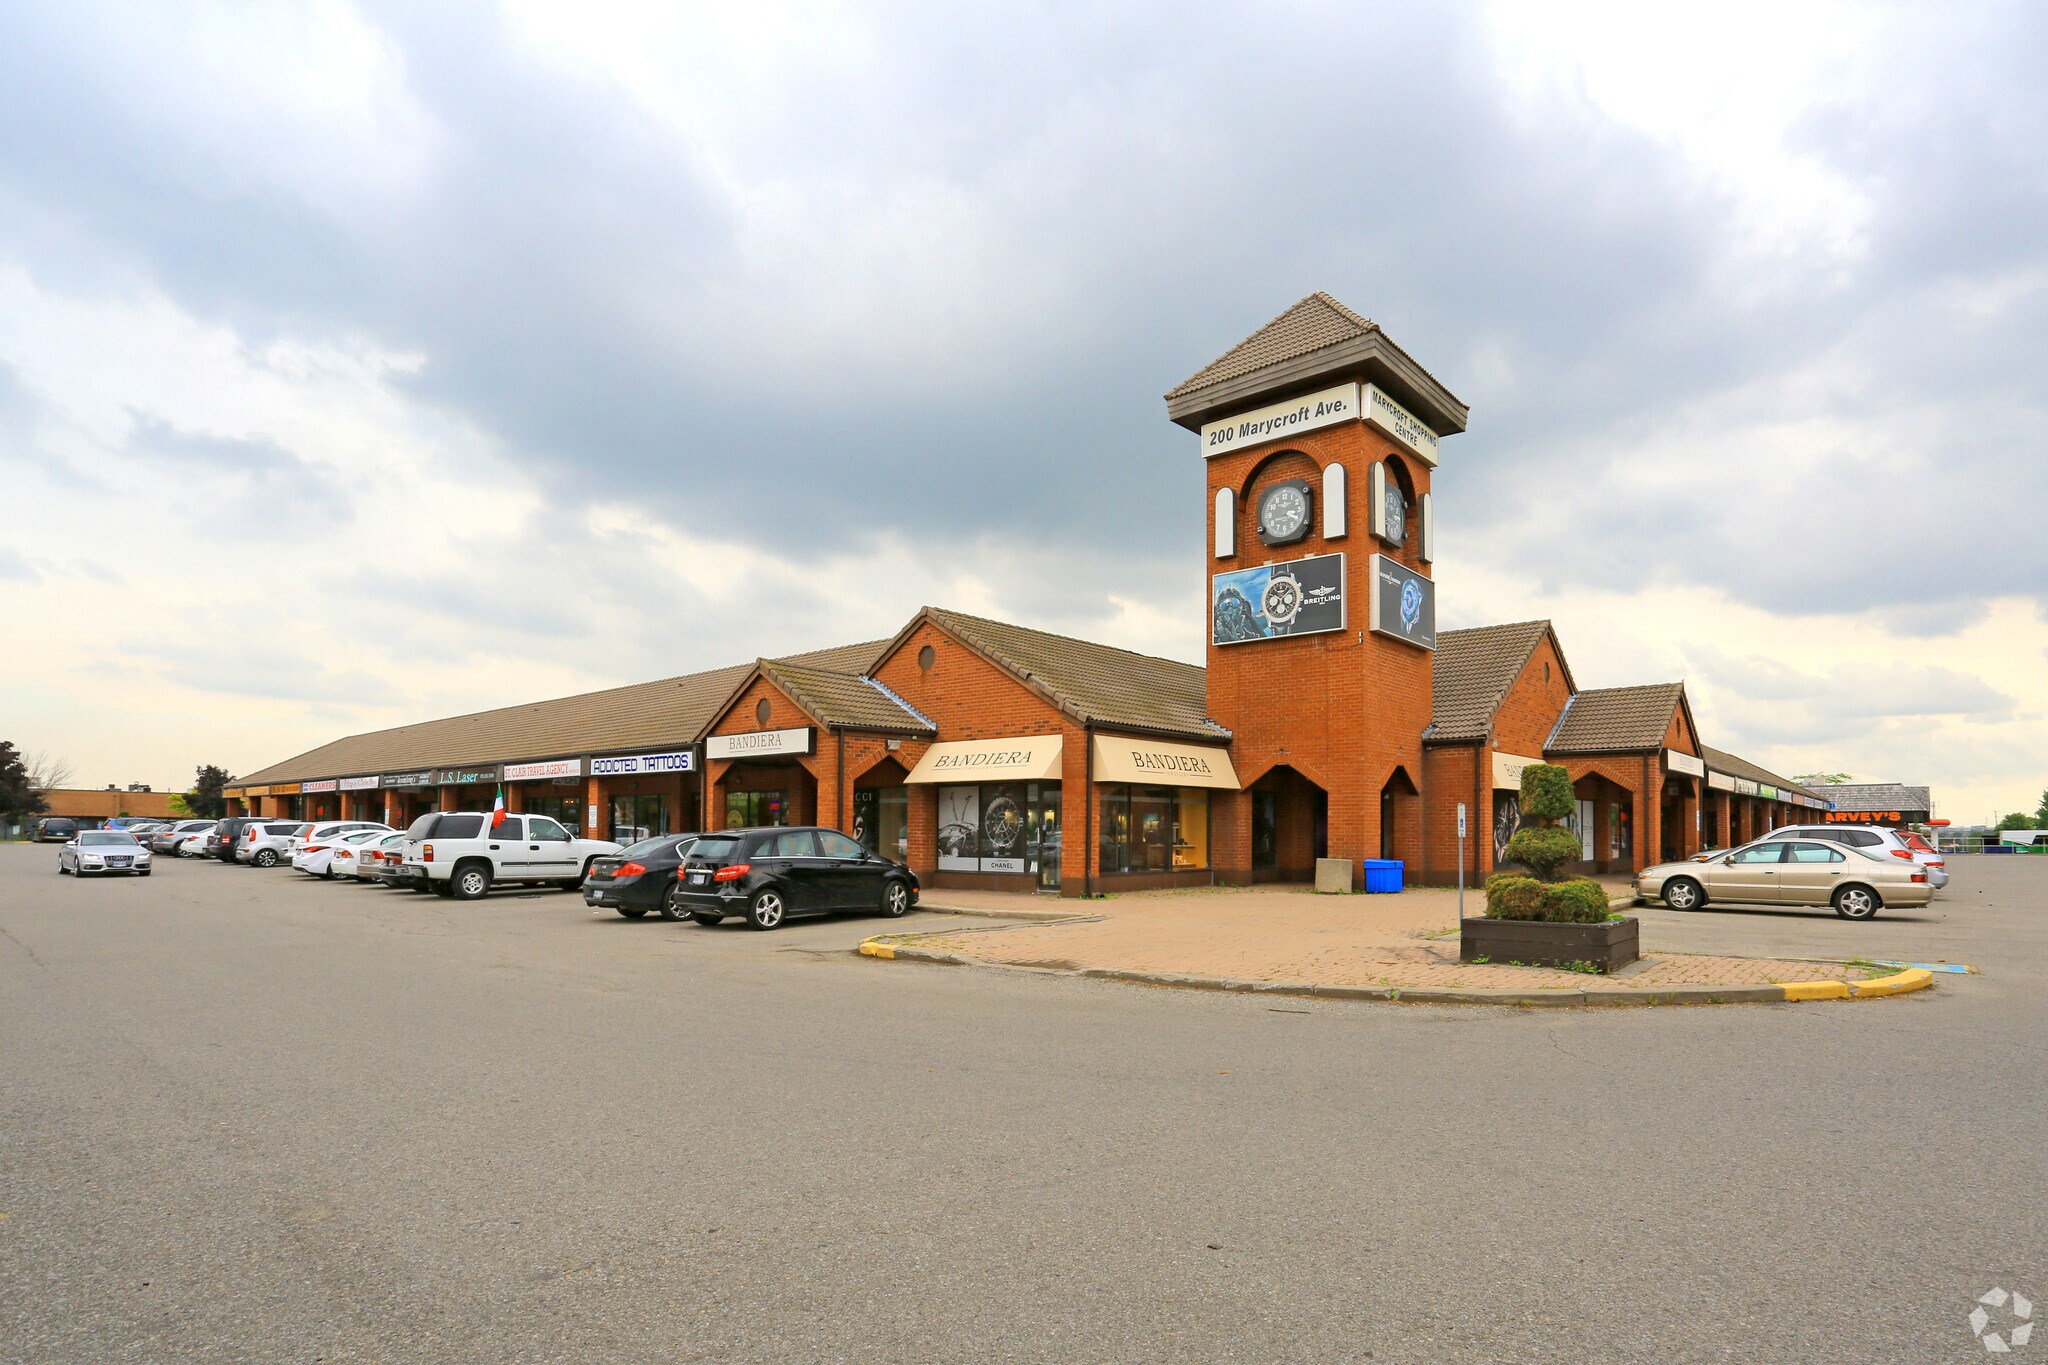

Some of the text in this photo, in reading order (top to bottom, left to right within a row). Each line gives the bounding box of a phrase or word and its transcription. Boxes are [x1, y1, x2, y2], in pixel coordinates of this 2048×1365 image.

[1210, 400, 1347, 446] 200 Marycroft Ave.
[1373, 391, 1437, 447] MARYCROFT SHOPPING
[1395, 422, 1418, 446] CENTRE
[1270, 503, 1276, 511] 10
[1304, 594, 1340, 605] BREITLING
[729, 733, 782, 750] BANDIERA
[593, 754, 689, 773] ADDICTED TATTOOS
[934, 751, 1032, 768] BANDIERA
[1131, 752, 1211, 773] BANDIERA
[440, 771, 454, 783] L.S.
[456, 771, 478, 783] Laser
[512, 767, 526, 777] CLAIR
[527, 765, 545, 776] TRAVEL
[546, 763, 569, 775] AGENCY
[309, 781, 336, 791] CLEANERS
[1825, 811, 1901, 822] ARVEY'S
